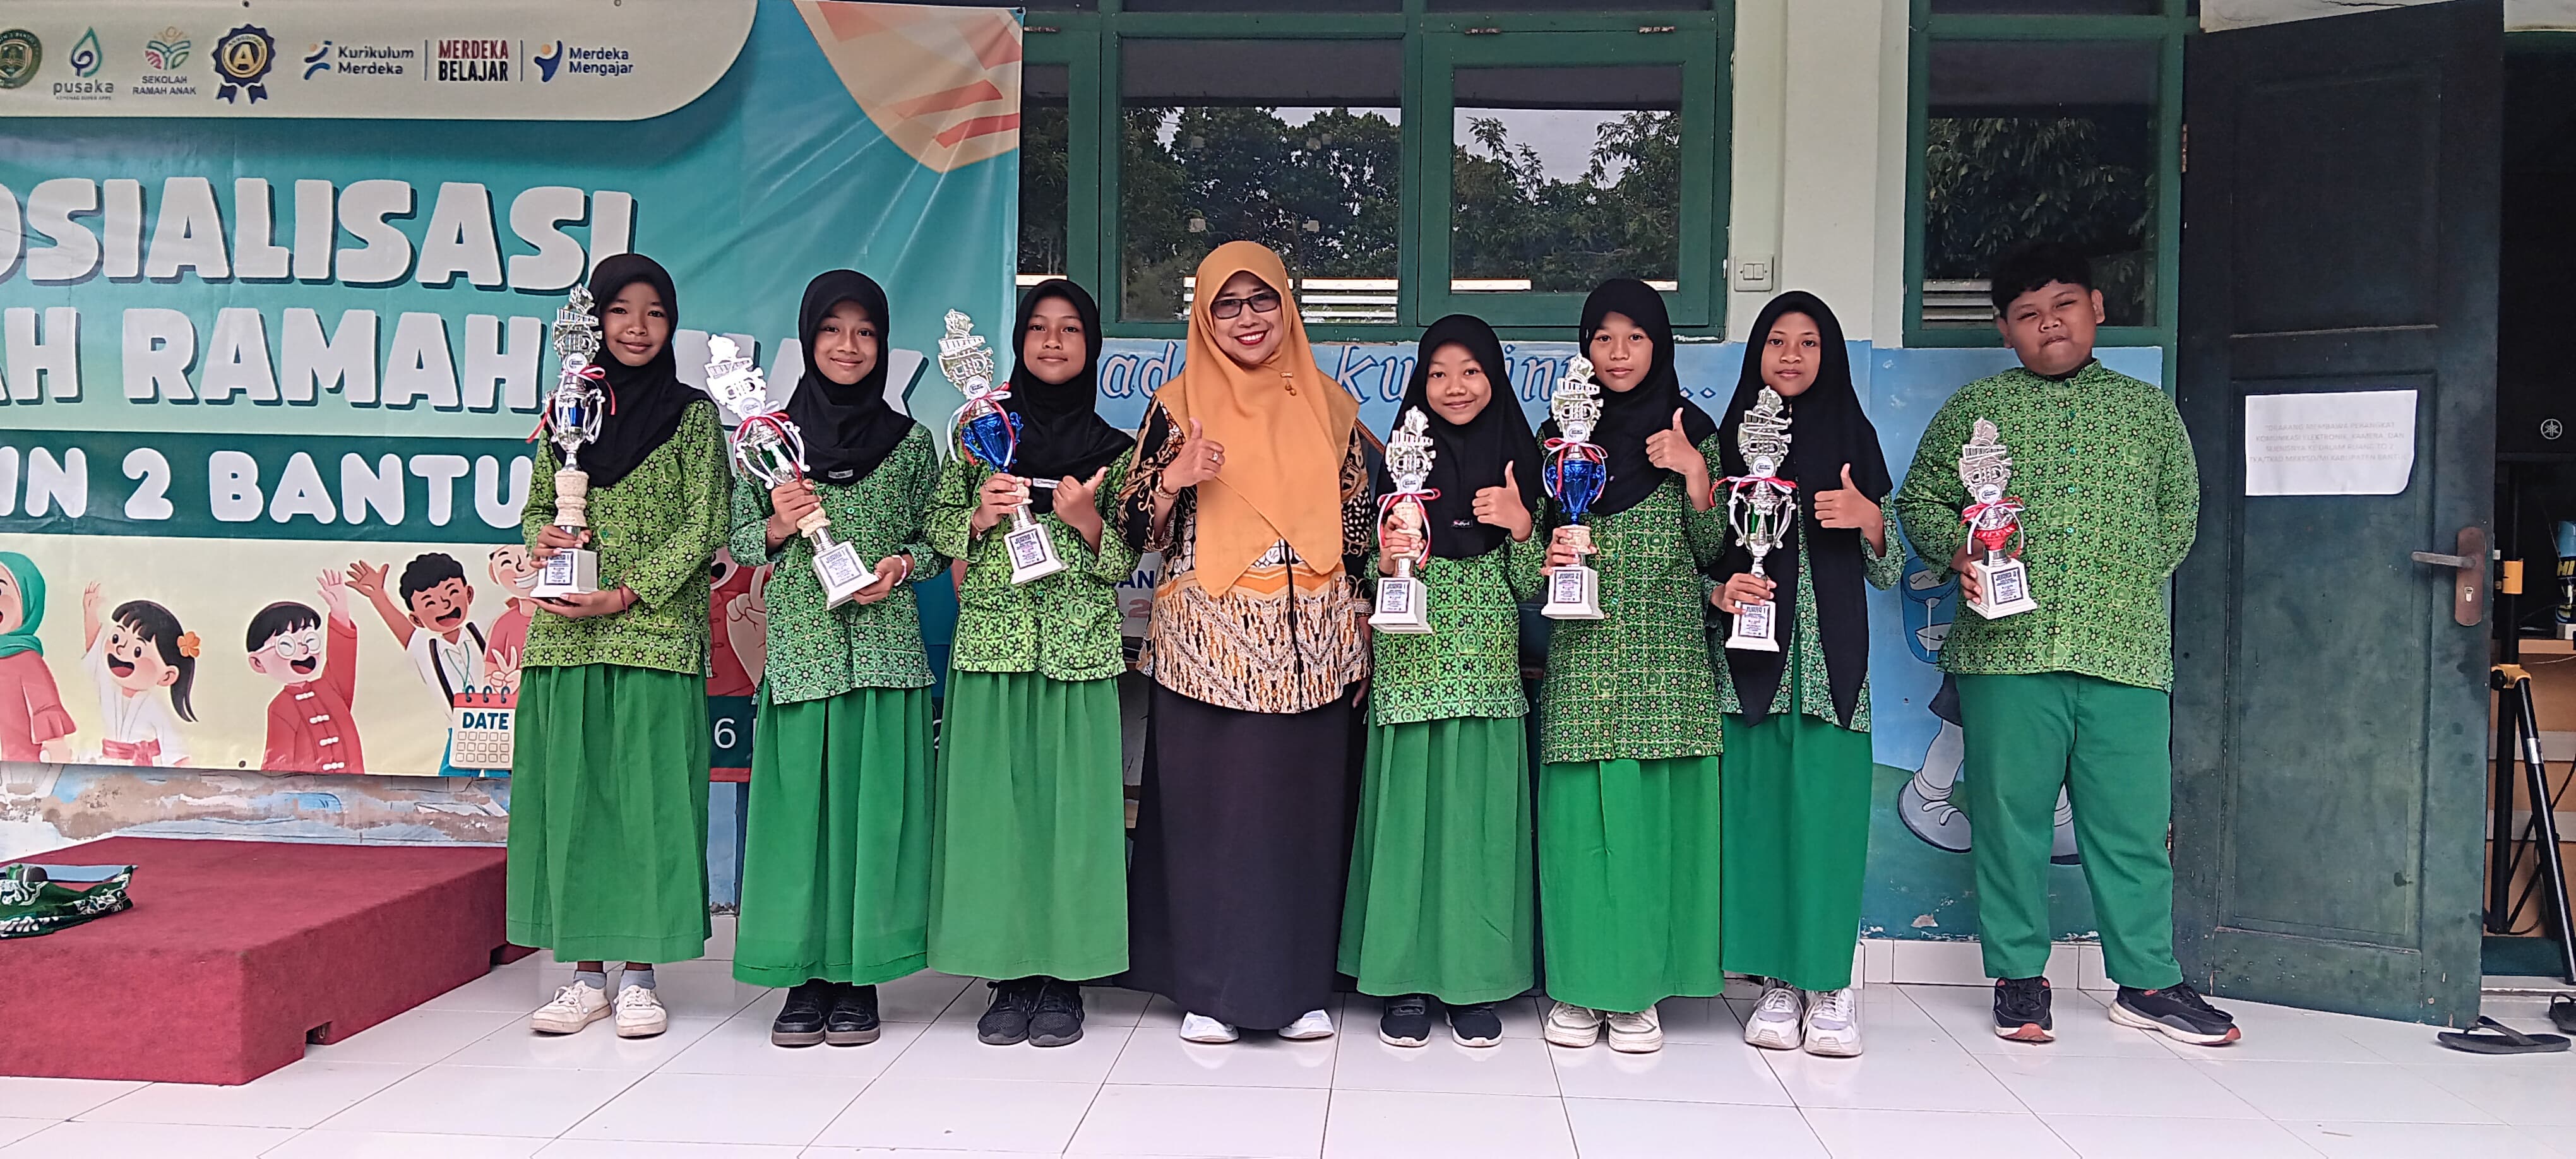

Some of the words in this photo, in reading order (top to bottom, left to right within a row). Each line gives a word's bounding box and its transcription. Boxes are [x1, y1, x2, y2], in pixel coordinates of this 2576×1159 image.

[232, 44, 256, 69] A
[338, 45, 414, 59] Kurikulum
[439, 40, 508, 59] MERDEKA
[569, 47, 629, 60] Merdeka
[338, 61, 403, 74] Merdeka
[439, 60, 508, 81] BELAJAR
[569, 61, 634, 76] Mengajar
[53, 80, 114, 95] pusaka
[141, 76, 188, 84] SEKOLAH
[132, 86, 167, 95] RAMAH
[169, 86, 197, 95] ANAK
[122, 307, 542, 410] RAMAH
[122, 447, 174, 520] 2
[208, 449, 534, 529] BANTU
[462, 711, 510, 730] DATE
